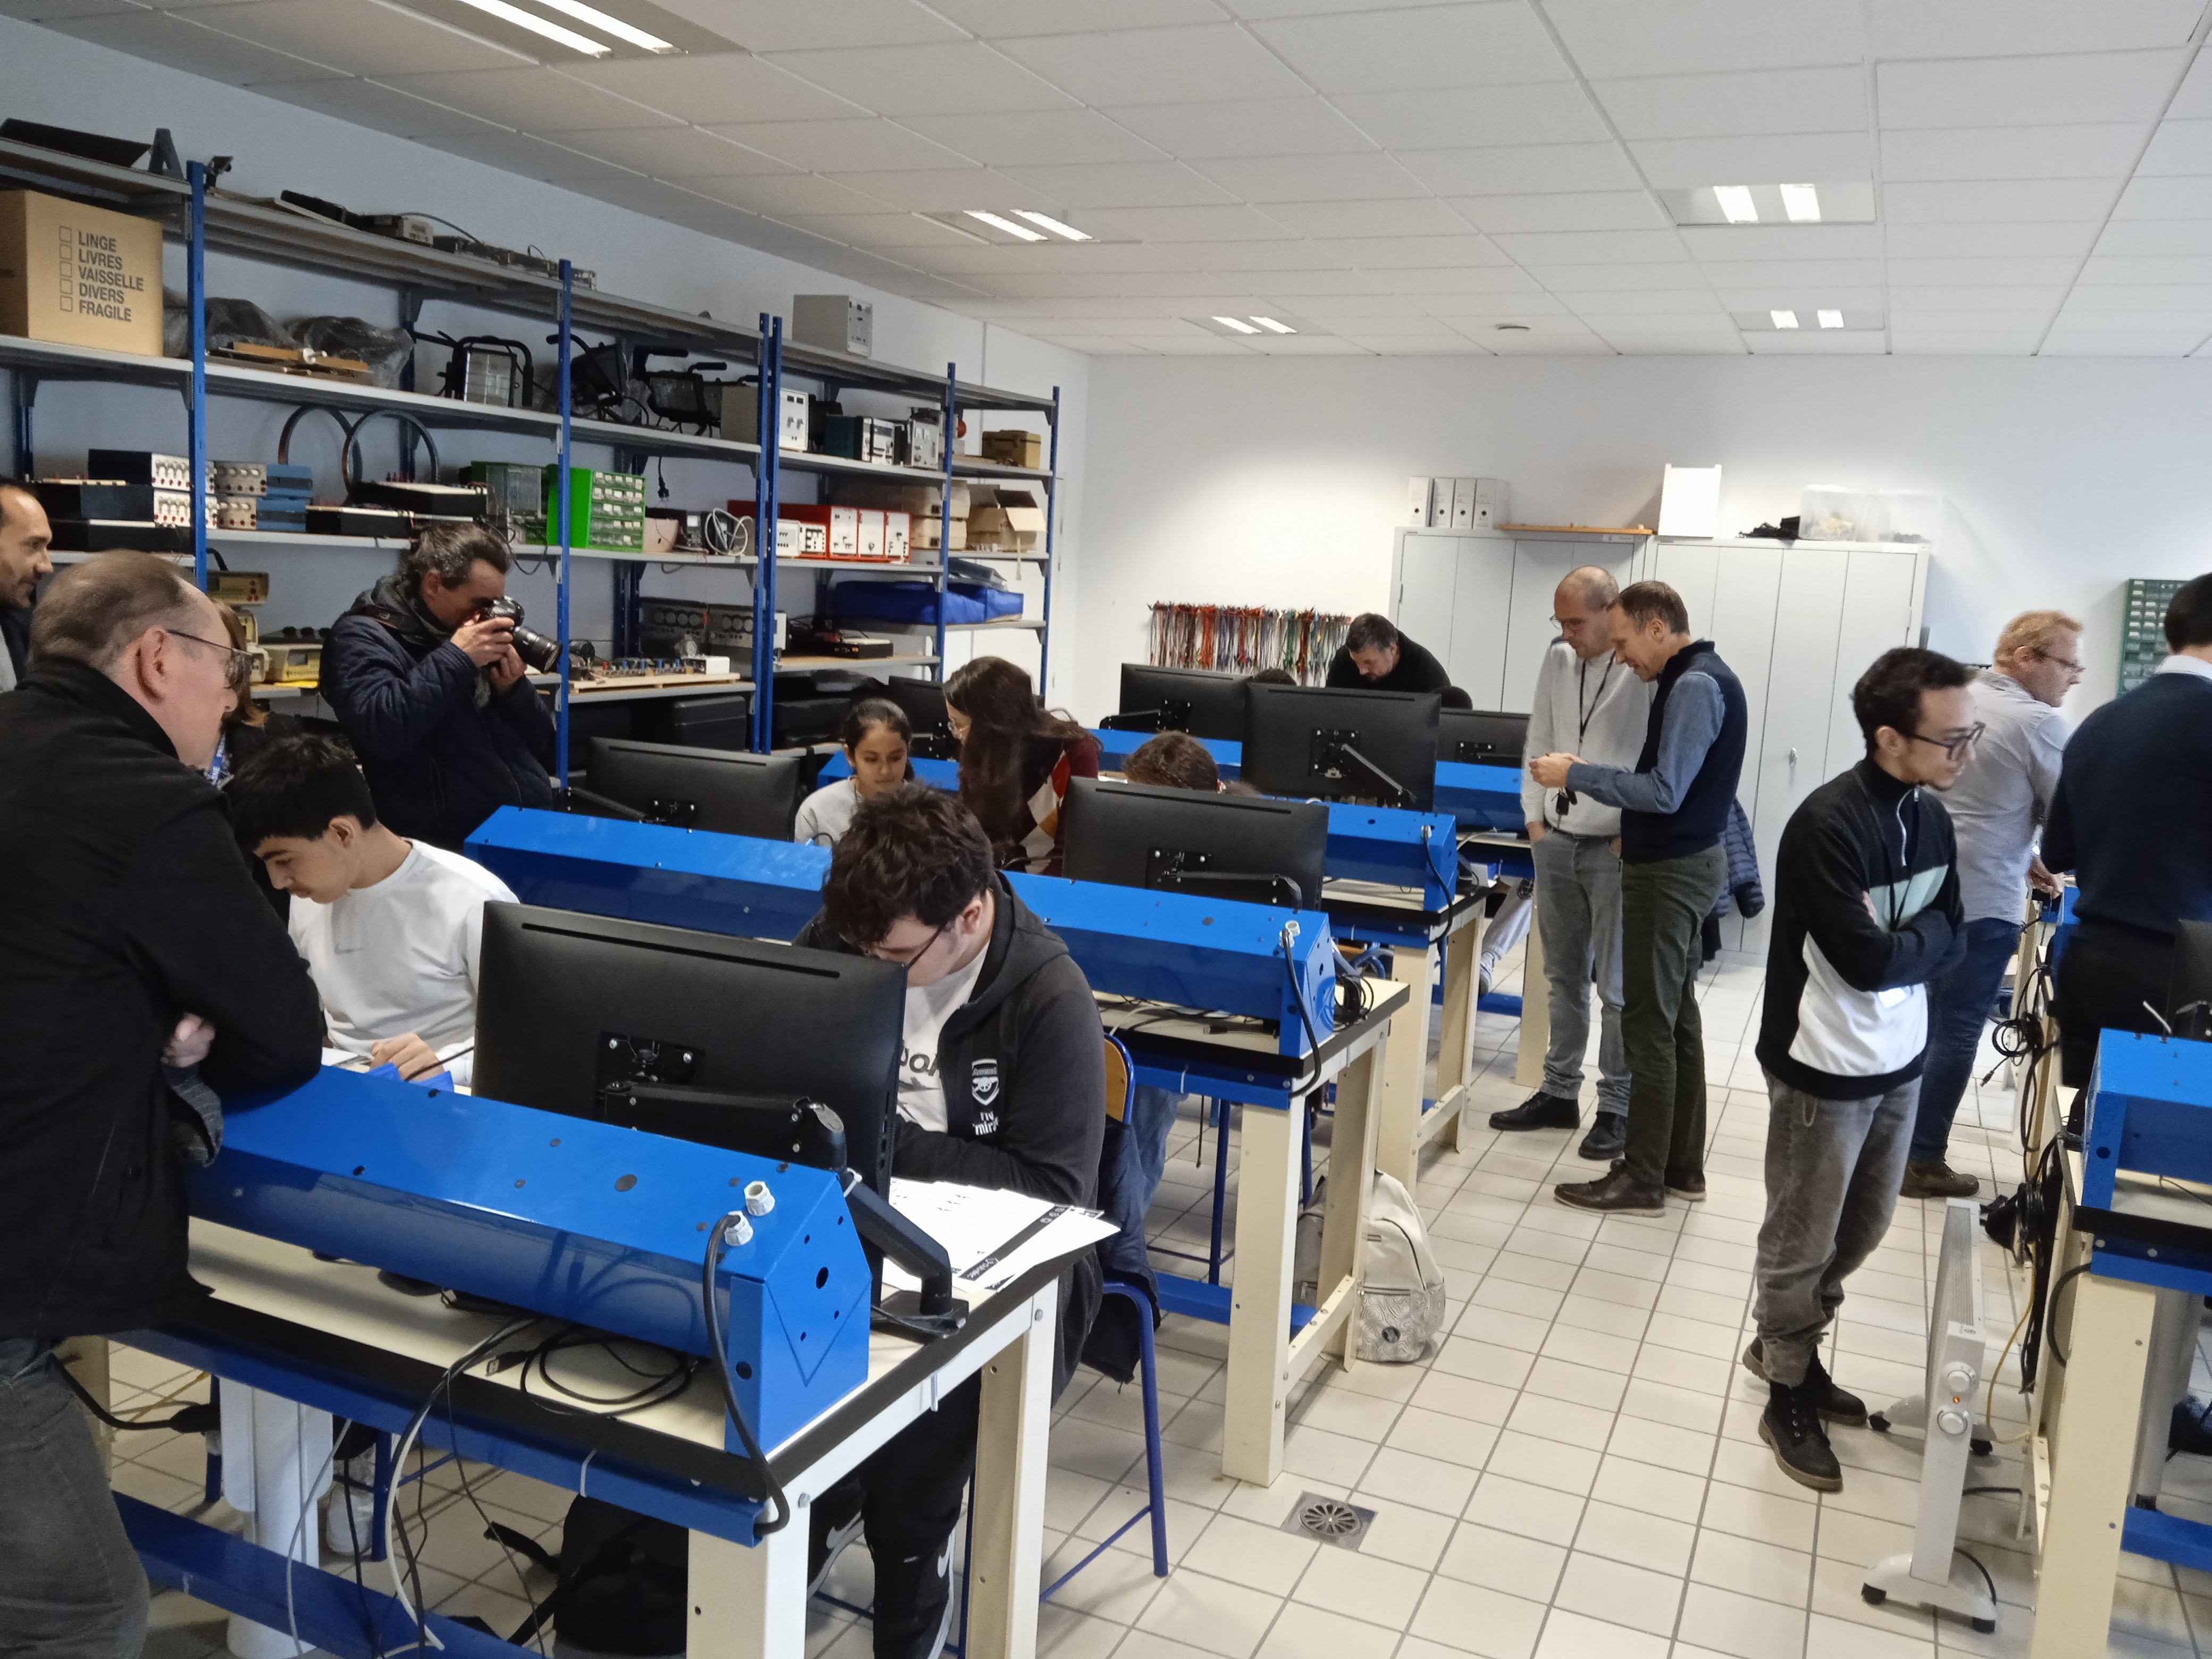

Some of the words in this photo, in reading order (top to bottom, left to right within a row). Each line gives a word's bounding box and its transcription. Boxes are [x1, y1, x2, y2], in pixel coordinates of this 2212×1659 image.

[79, 231, 116, 253] LINGE
[79, 249, 123, 270] LIVRES
[78, 265, 144, 291] VAISSELLE
[79, 282, 125, 304] DIVERS
[79, 299, 131, 322] FRAGILE
